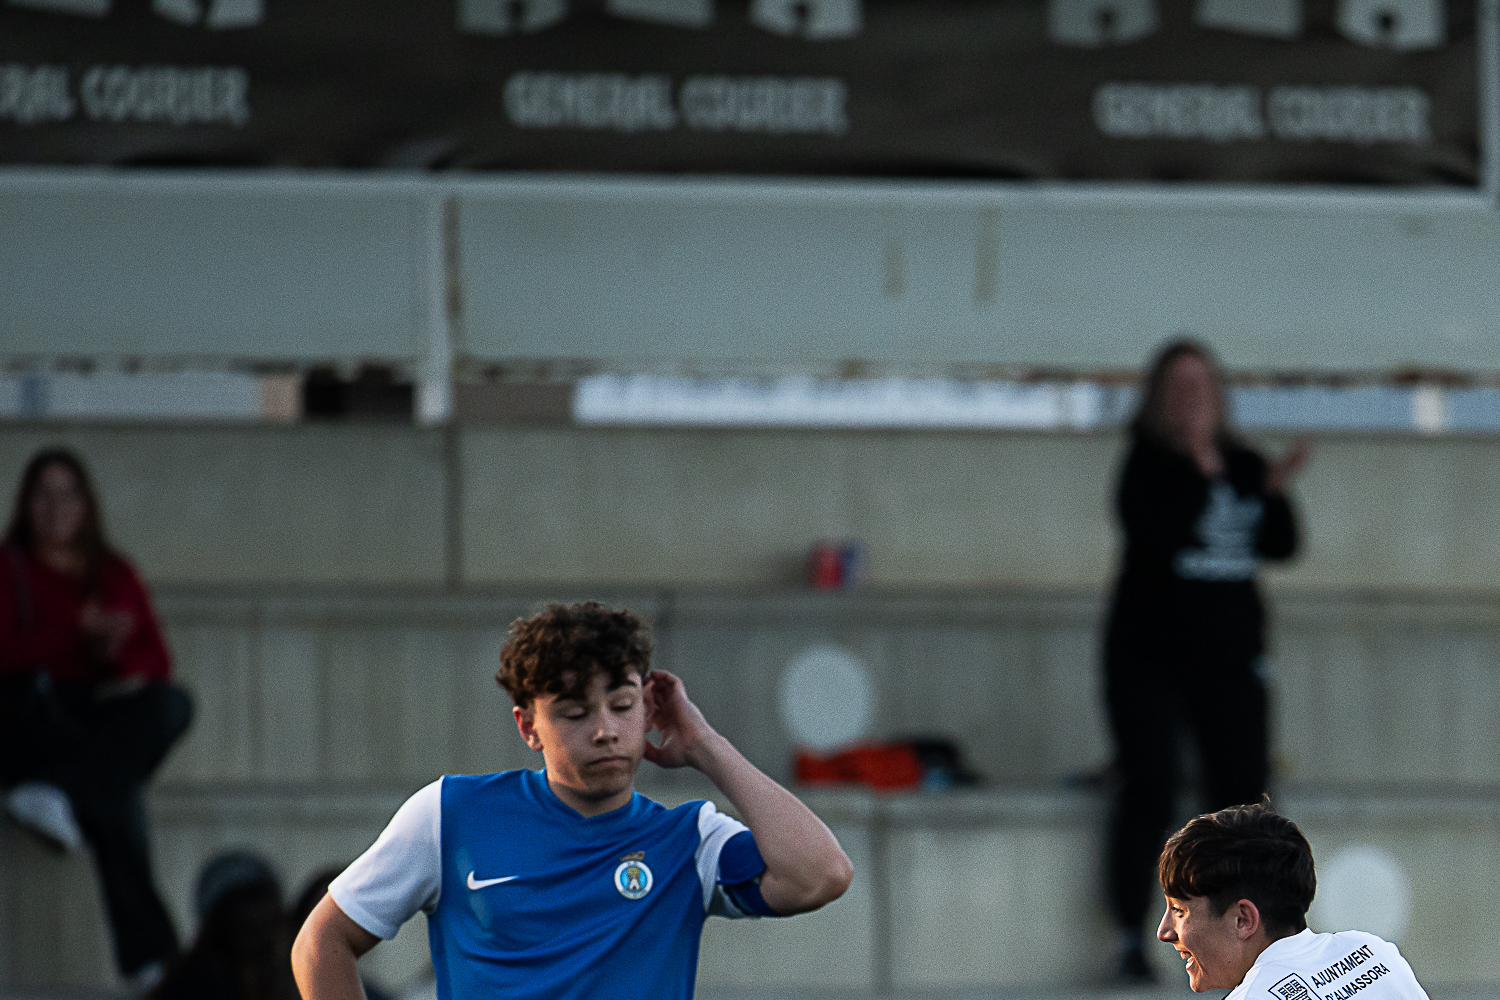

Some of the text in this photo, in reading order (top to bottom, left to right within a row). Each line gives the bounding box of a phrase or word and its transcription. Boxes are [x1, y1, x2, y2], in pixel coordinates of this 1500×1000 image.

[504, 72, 848, 135] GENERAL COURIER
[1094, 82, 1430, 145] GENERAL COURIER
[1311, 944, 1374, 989] AJUNTAMENT
